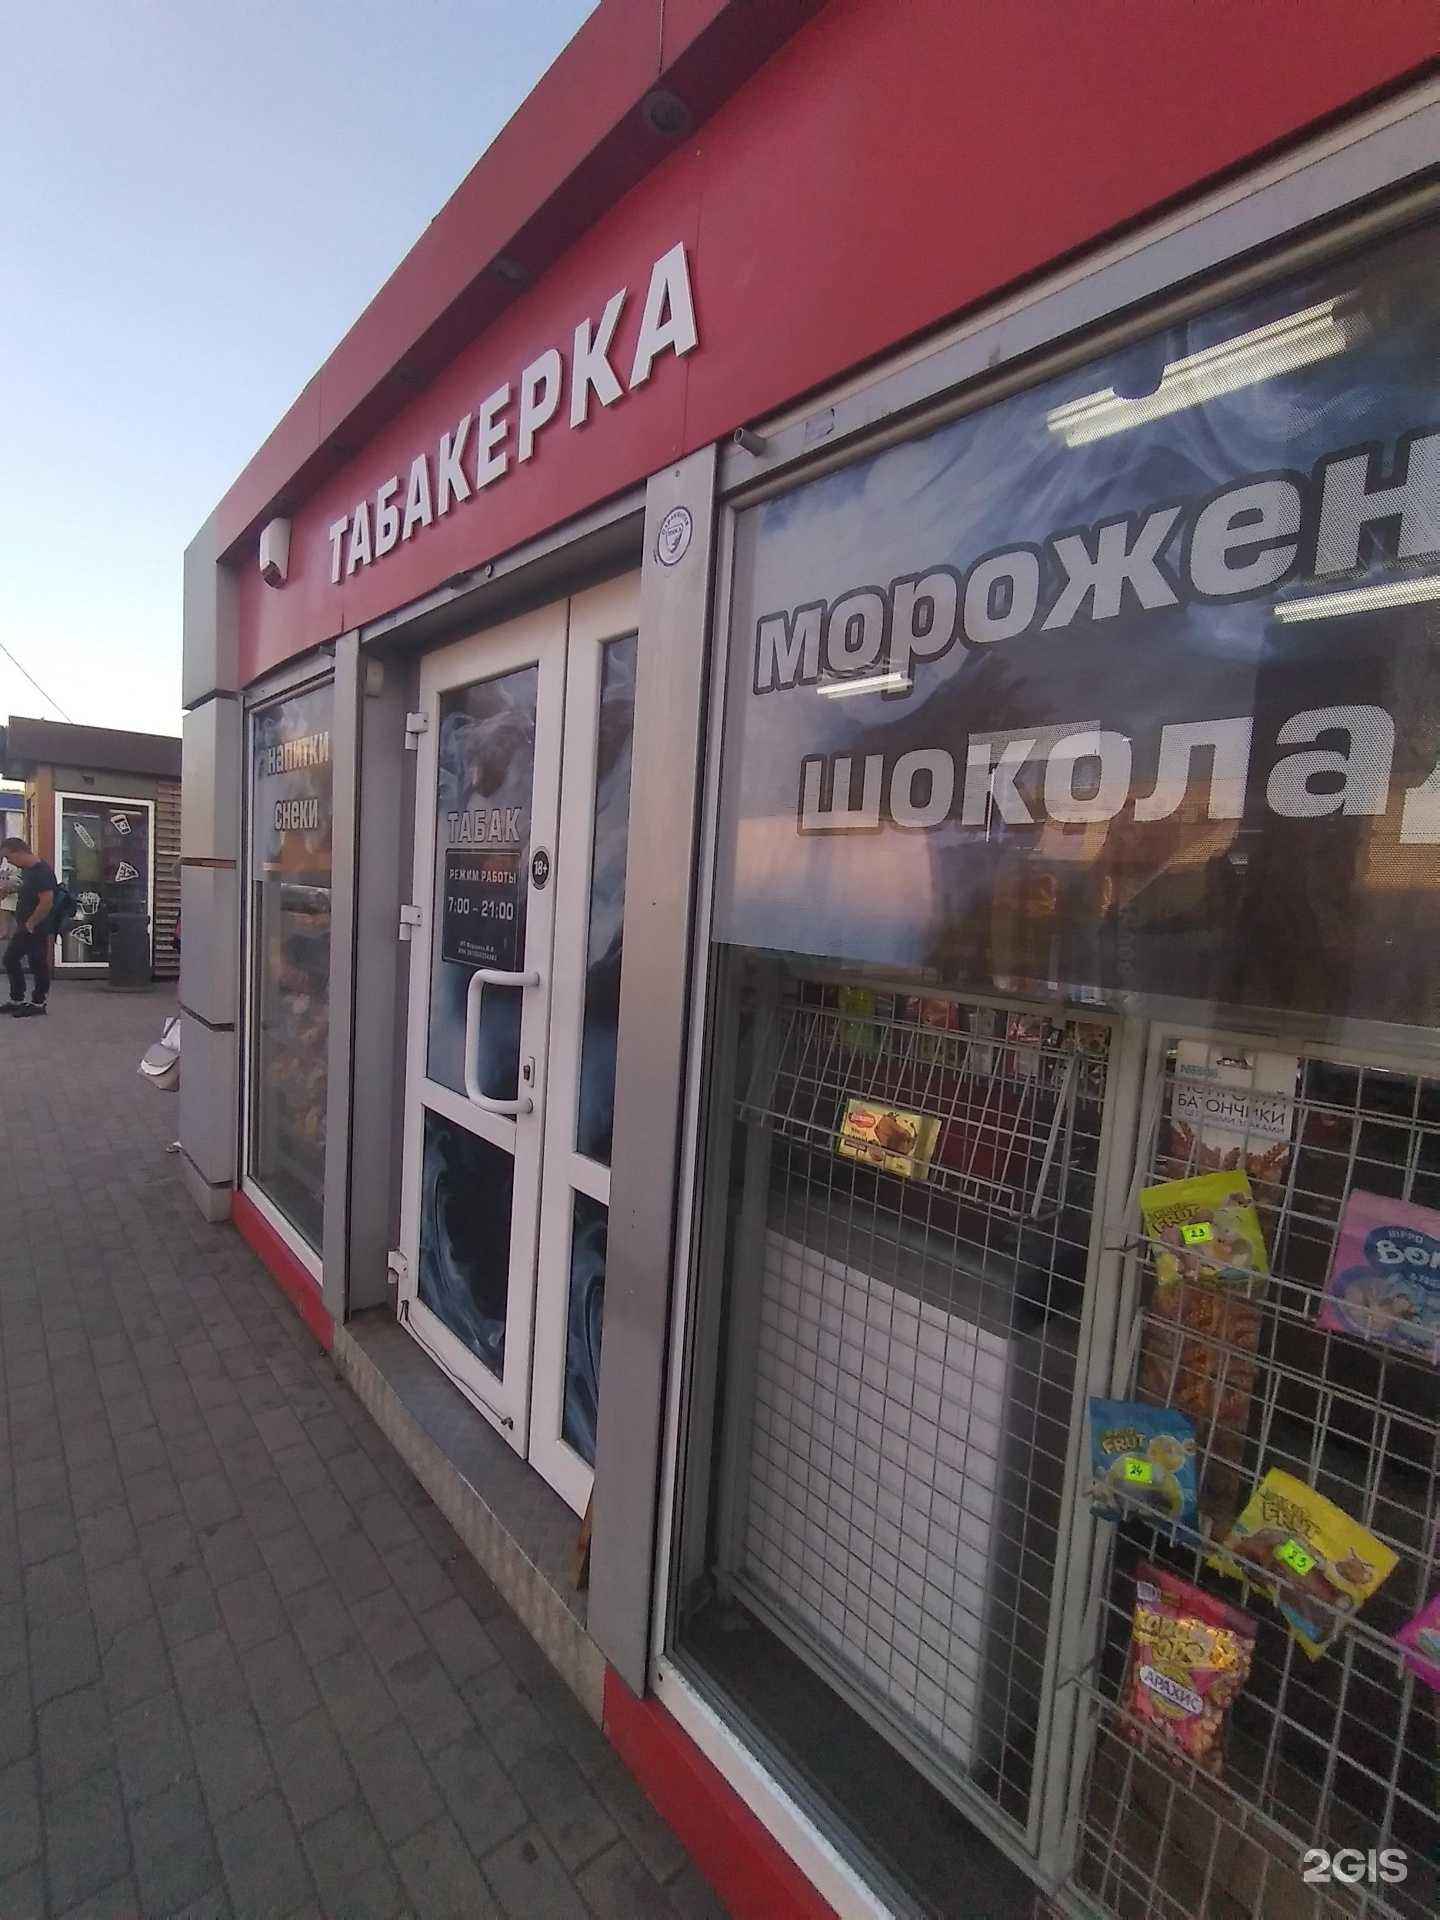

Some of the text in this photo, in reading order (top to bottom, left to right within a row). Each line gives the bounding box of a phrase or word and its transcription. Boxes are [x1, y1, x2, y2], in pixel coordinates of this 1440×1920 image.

[329, 241, 699, 584] ТАБАКЕРКА
[799, 703, 1440, 844] шокола
[447, 806, 522, 844] ТАБАК
[449, 868, 517, 885] РЕЖИМ РАБОТЫ
[533, 859, 548, 876] 18+
[448, 896, 470, 915] 7:00
[481, 900, 515, 920] 21:00
[1177, 1092, 1286, 1126] БАОНЧИКИ
